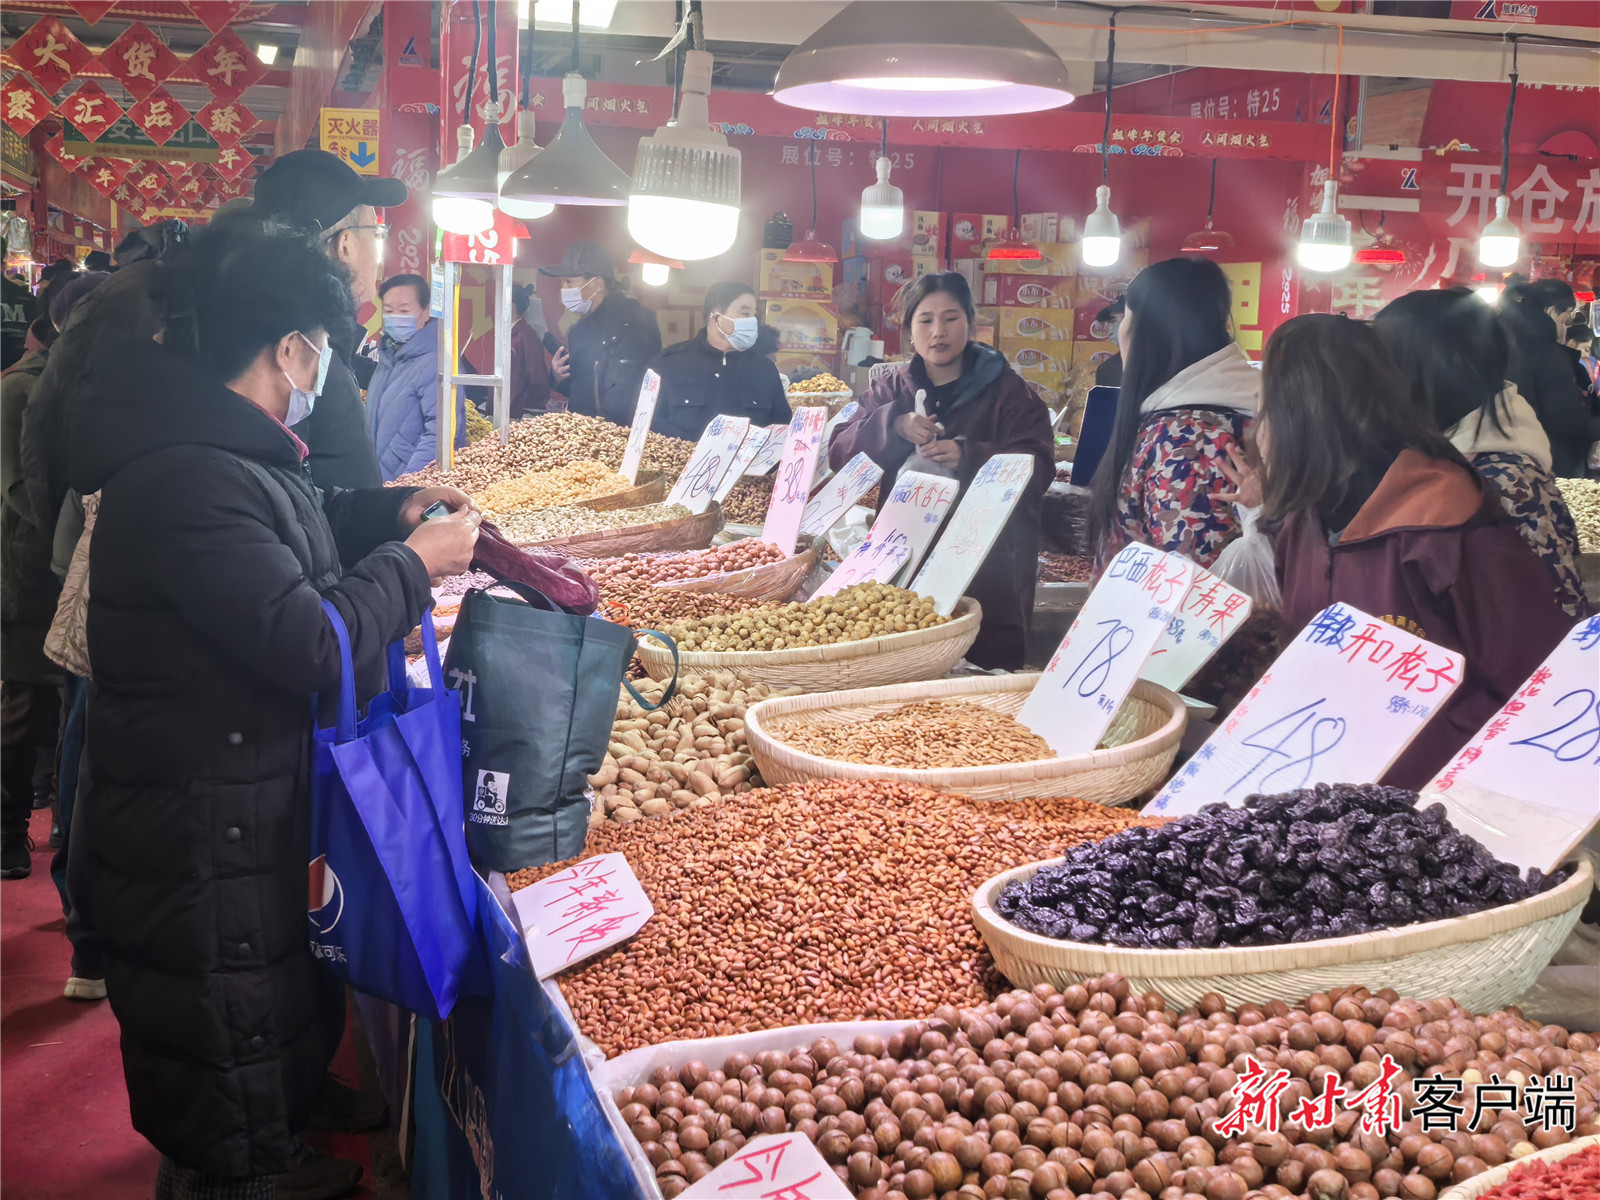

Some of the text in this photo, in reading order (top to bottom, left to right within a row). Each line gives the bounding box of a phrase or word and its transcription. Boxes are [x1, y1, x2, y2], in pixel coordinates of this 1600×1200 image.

[33, 34, 71, 74] 大
[123, 41, 156, 82] 货
[206, 46, 248, 86] 年
[6, 90, 35, 121] 聚
[453, 55, 517, 124] 福
[74, 98, 106, 125] 汇
[144, 100, 173, 129] 品
[327, 117, 379, 136] 灭火器
[1202, 130, 1272, 148] 人间烟火气
[391, 147, 430, 191] 福
[399, 229, 423, 275] 202
[1109, 547, 1185, 604] 巴西松子
[1062, 618, 1135, 698] 78
[1224, 698, 1347, 797] 48
